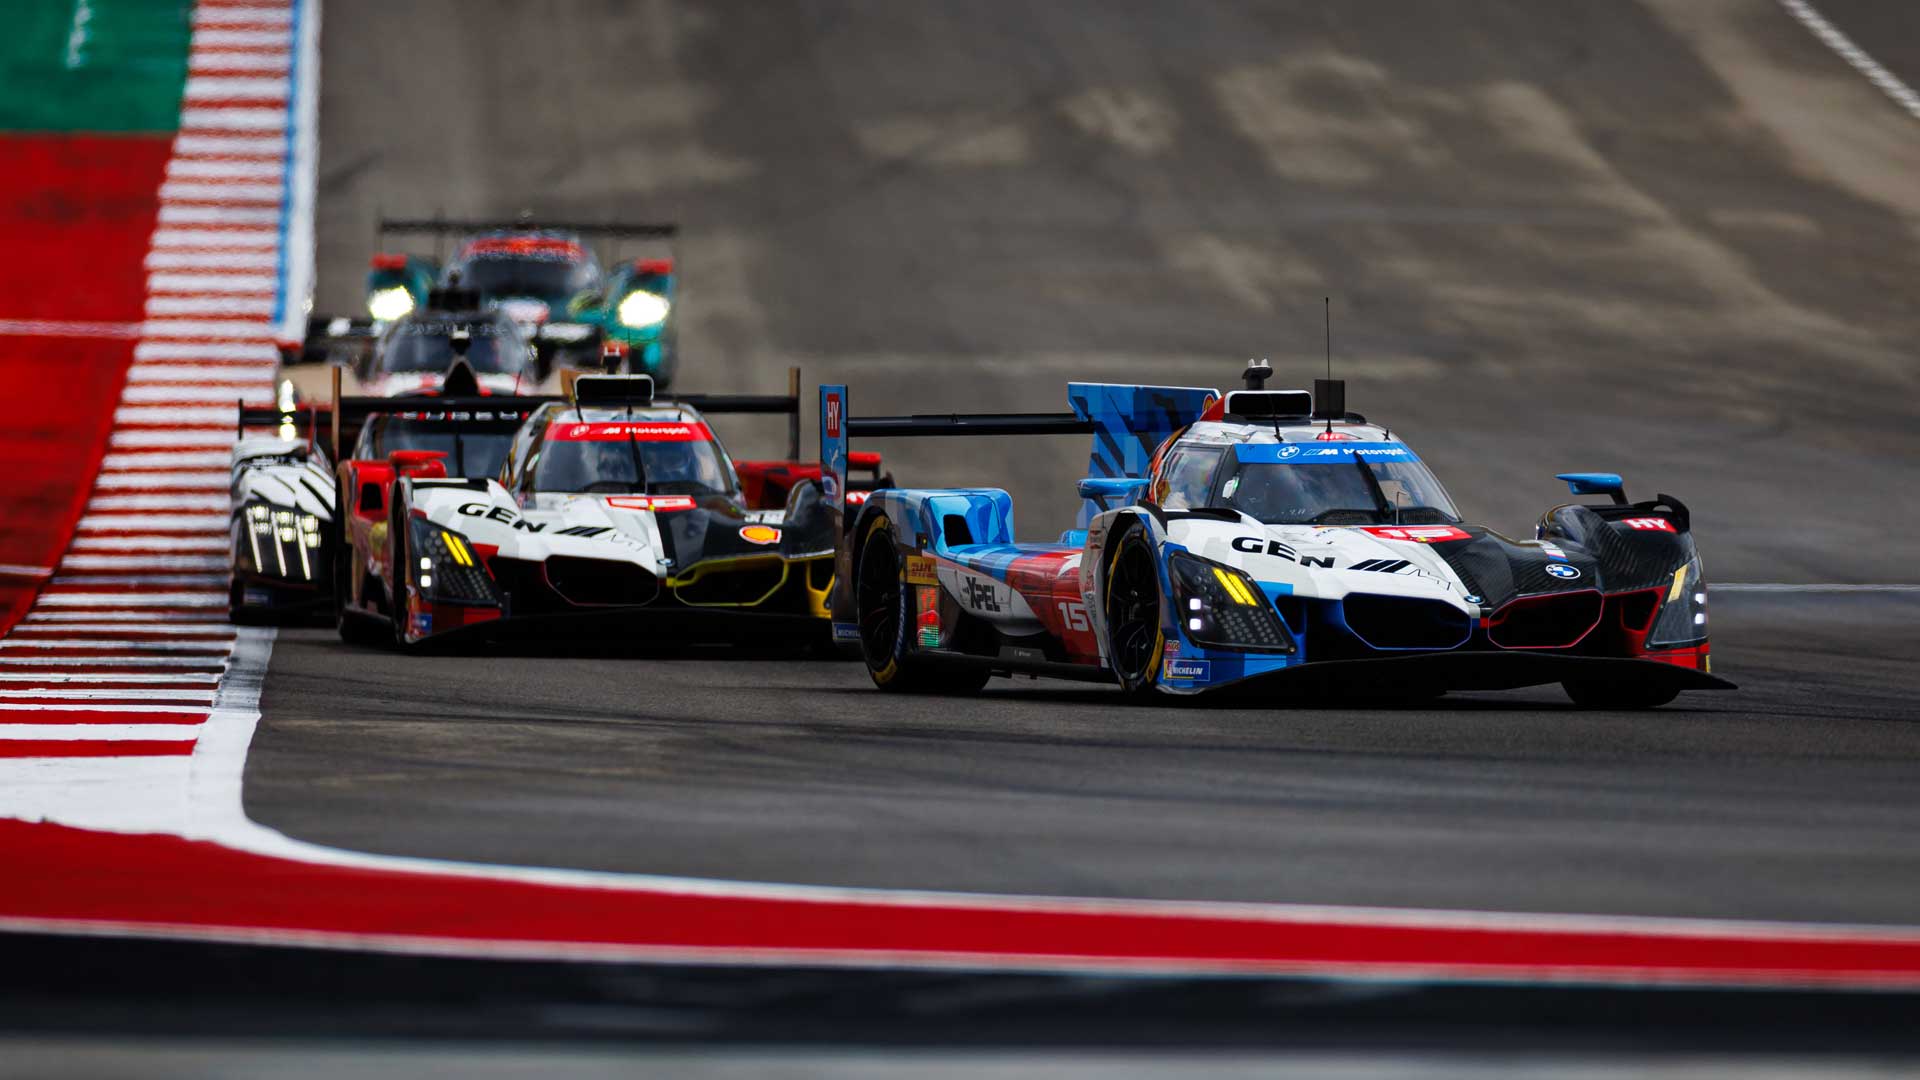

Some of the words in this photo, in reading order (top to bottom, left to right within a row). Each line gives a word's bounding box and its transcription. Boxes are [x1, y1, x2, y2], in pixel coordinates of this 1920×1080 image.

[827, 402, 839, 430] HY
[1342, 448, 1407, 456] Motorsport
[457, 502, 547, 533] GEN
[1626, 519, 1666, 528] HY
[1231, 536, 1335, 568] GEN
[965, 576, 1001, 612] XPEL
[1058, 602, 1090, 632] 15
[1173, 666, 1204, 675] MICHELIN
